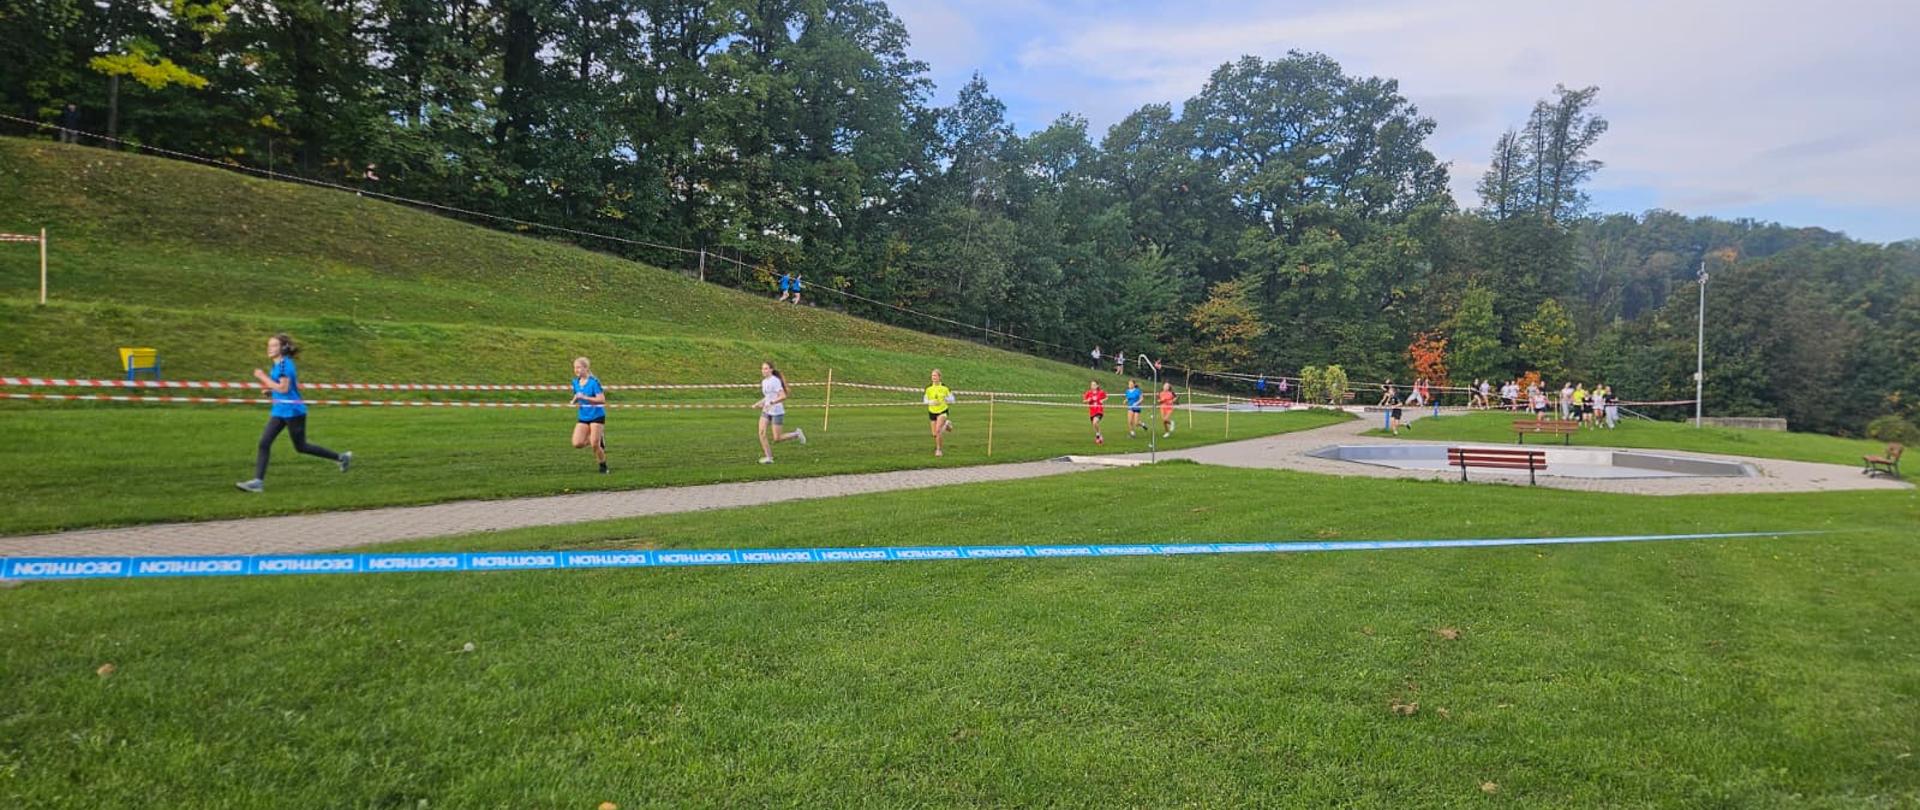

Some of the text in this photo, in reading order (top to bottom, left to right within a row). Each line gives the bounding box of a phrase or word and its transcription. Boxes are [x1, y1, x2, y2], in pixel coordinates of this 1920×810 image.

[369, 557, 458, 569] DECATHLON
[472, 555, 555, 567] DECATHLON
[568, 554, 646, 565] DECATHLON
[658, 553, 731, 563] DECATHLON
[742, 552, 810, 562] DECATHLON
[13, 562, 121, 575] DECATHLON
[140, 560, 242, 573] DECATHLON
[259, 558, 354, 571] DECATHLON
